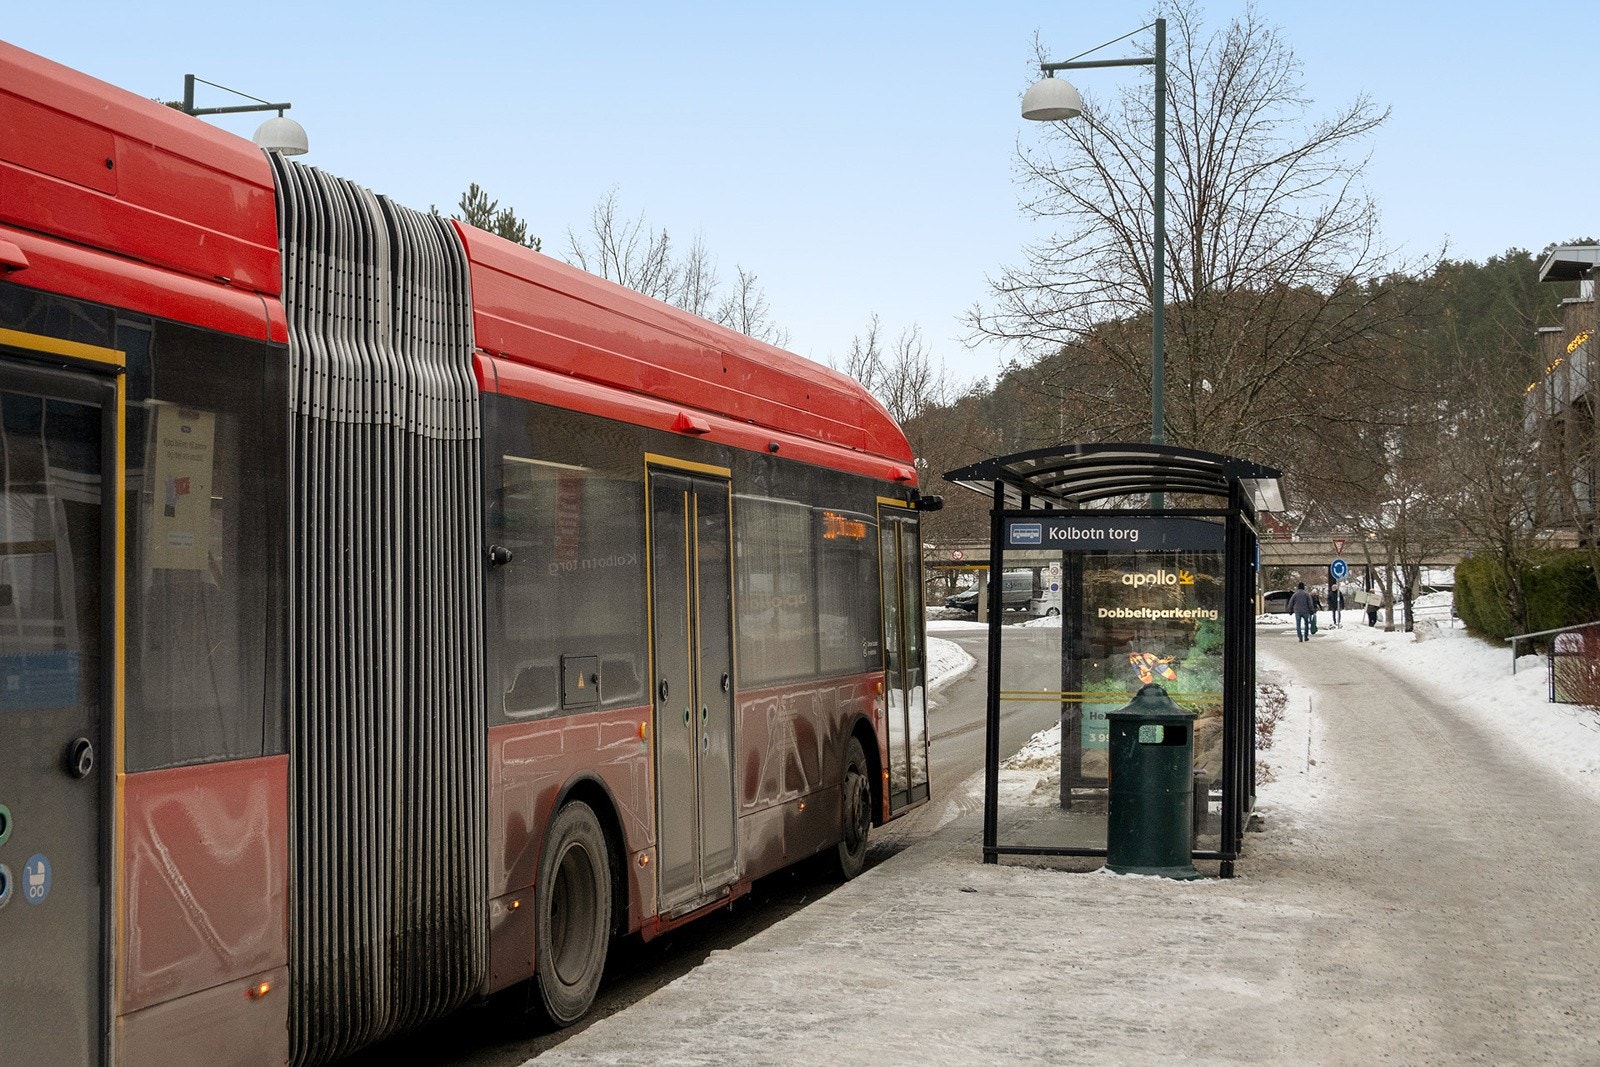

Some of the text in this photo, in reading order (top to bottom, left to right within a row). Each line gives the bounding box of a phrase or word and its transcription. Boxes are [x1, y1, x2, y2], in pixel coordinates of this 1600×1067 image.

[1049, 527, 1139, 542] Kolbotn torg
[1121, 570, 1177, 588] apollo
[1097, 607, 1219, 621] Dobbeltparkering
[1089, 711, 1106, 721] He
